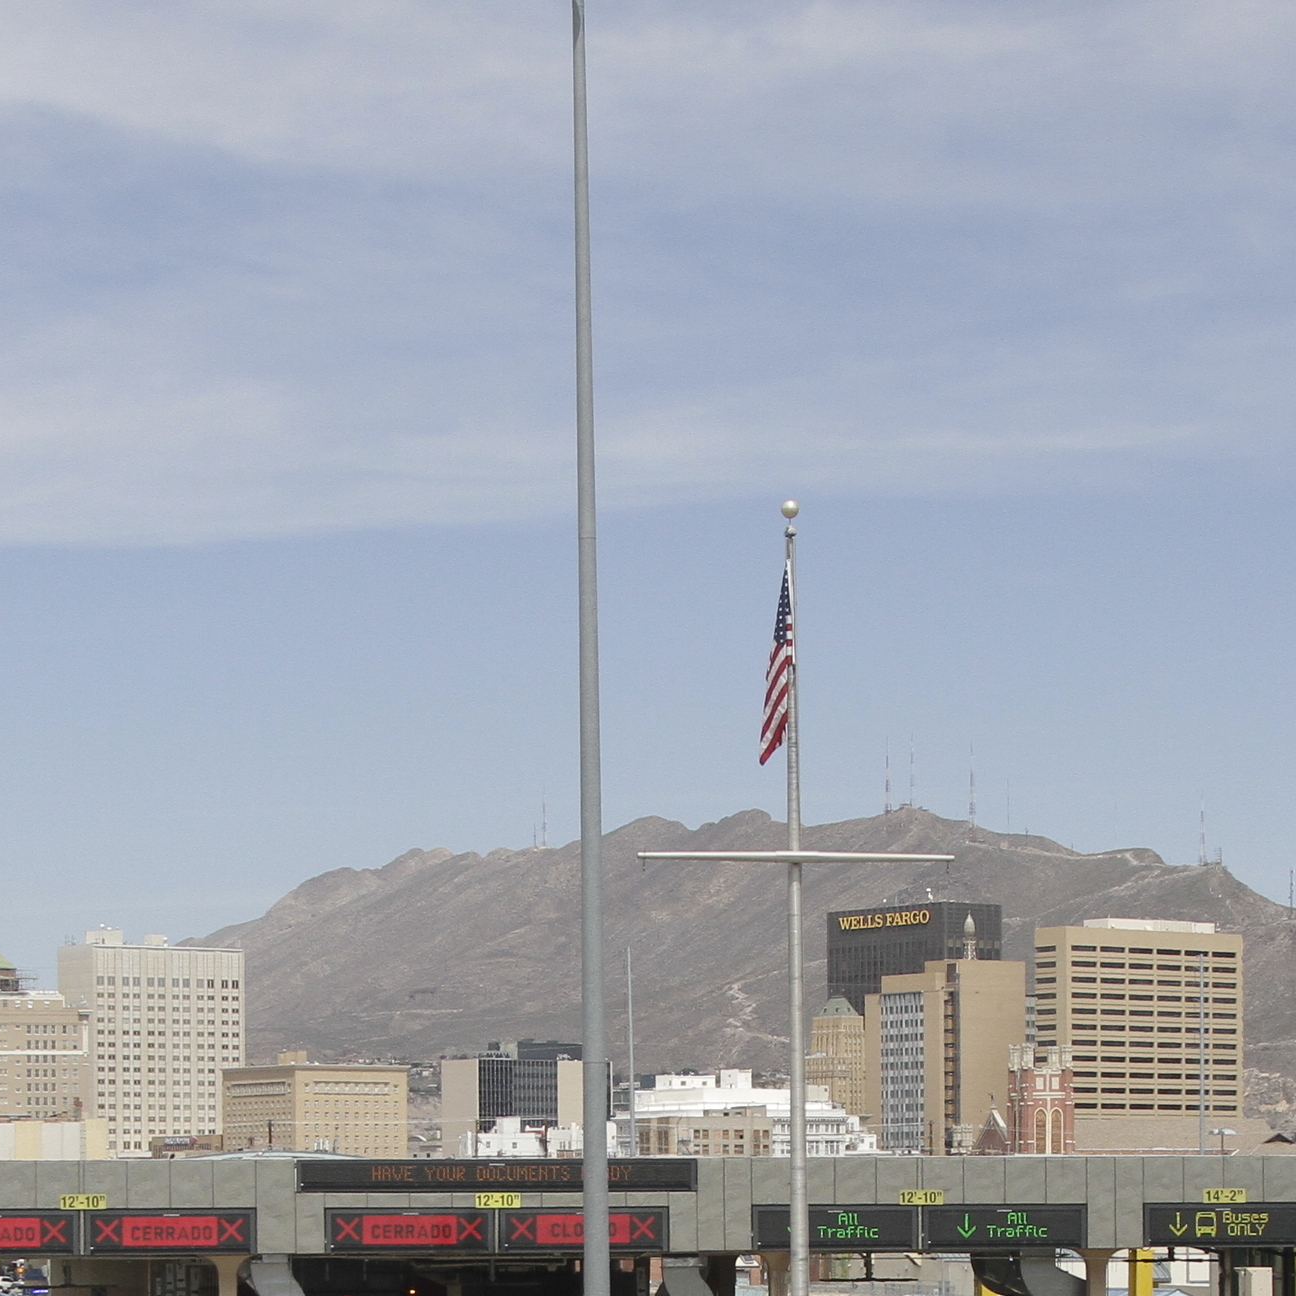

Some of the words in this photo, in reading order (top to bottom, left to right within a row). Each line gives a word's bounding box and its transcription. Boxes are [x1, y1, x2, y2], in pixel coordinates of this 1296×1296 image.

[838, 914, 883, 930] WELLS
[885, 909, 930, 927] FARGO
[372, 1166, 414, 1181] HAVE
[425, 1166, 466, 1181] YOUR
[476, 1165, 571, 1181] DOCUMENTS
[838, 1212, 858, 1226] All
[1007, 1212, 1027, 1225] All
[1222, 1211, 1269, 1223] Buses
[131, 1226, 213, 1241] CERRADO
[371, 1224, 452, 1238] CERRADO
[551, 1223, 617, 1237] CLOD
[817, 1226, 879, 1239] Traffic
[987, 1225, 1048, 1238] Traffic
